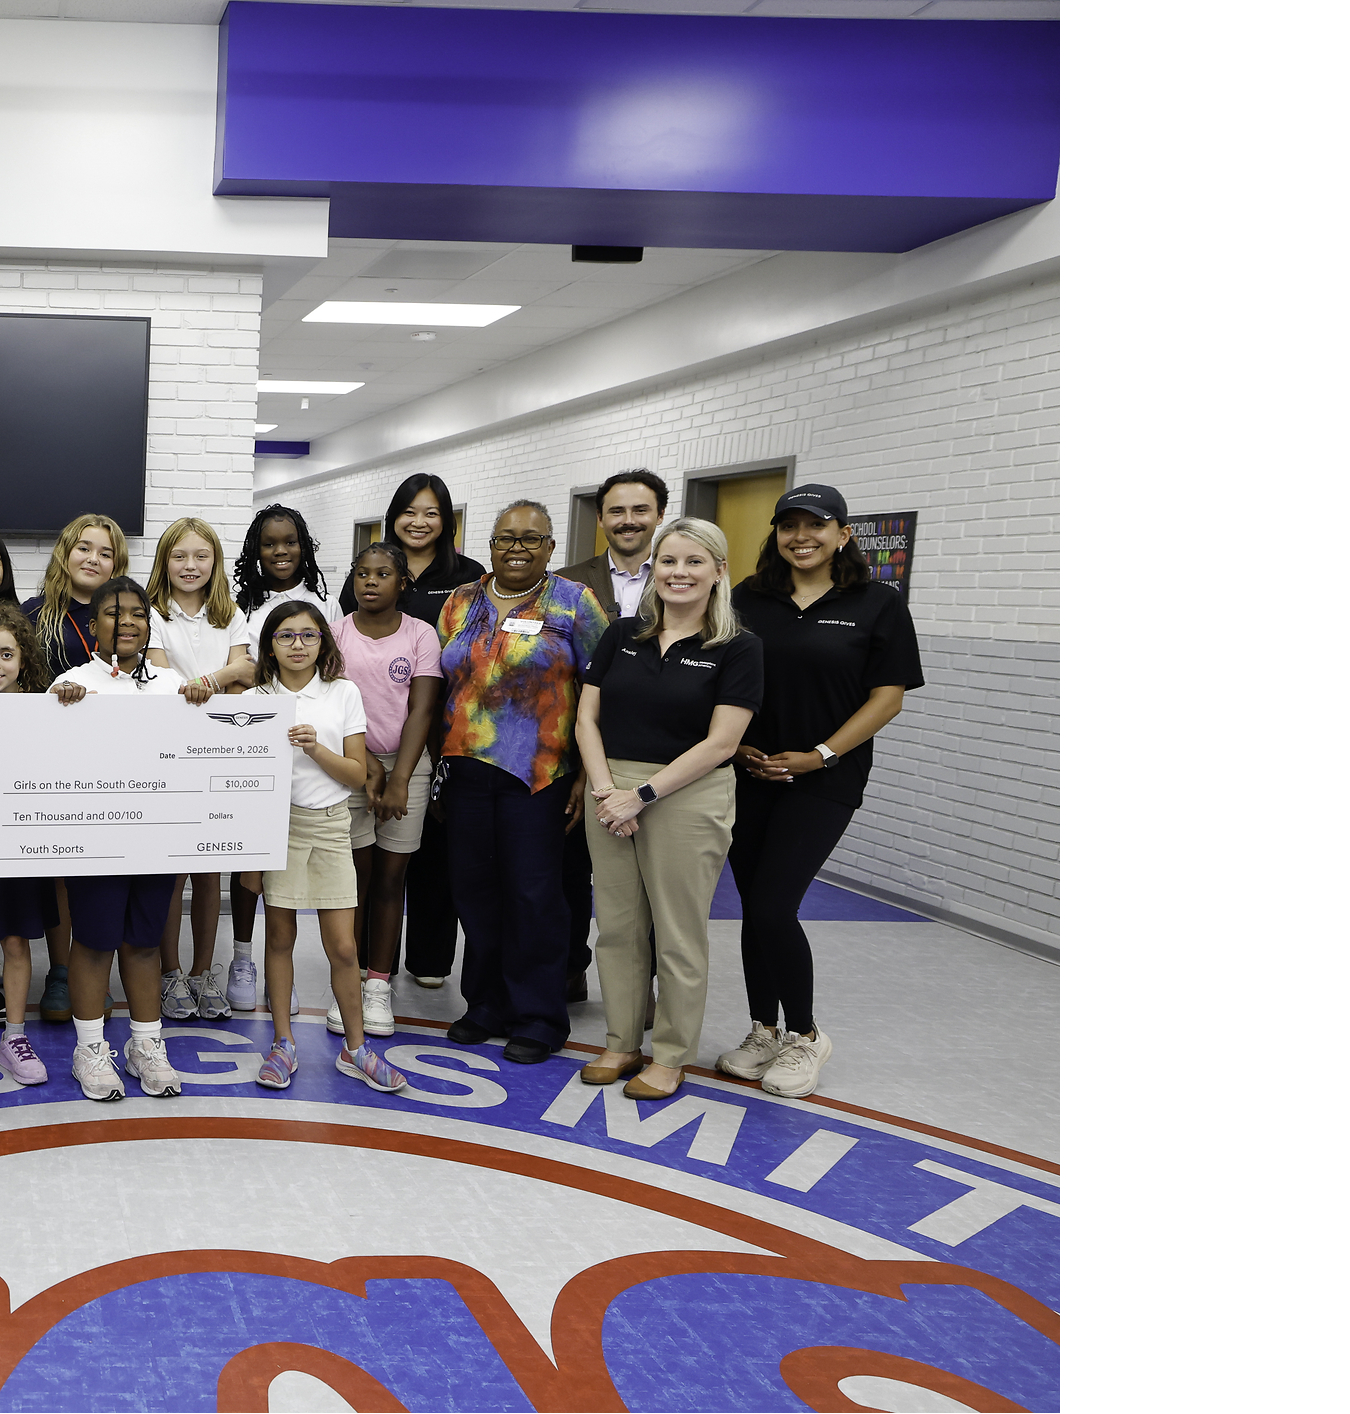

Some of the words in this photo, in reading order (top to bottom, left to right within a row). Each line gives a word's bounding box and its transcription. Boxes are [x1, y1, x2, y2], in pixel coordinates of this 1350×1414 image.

[850, 522, 877, 536] SCHOOL
[858, 535, 908, 551] COUNSELORS:
[392, 665, 409, 676] JGS
[187, 746, 234, 755] September
[237, 746, 244, 754] 9,
[14, 781, 35, 789] Girls
[37, 782, 51, 790] on
[55, 781, 71, 789] the
[75, 781, 93, 789] Run
[97, 780, 125, 789] South
[128, 779, 167, 791] Georgia
[226, 780, 259, 789] $10,000
[13, 812, 31, 821] Ten
[35, 812, 83, 820] Thousand
[86, 811, 104, 820] and
[108, 811, 142, 820] 00/100
[20, 845, 49, 854] Youth
[52, 845, 84, 855] Sports
[197, 842, 243, 851] GENESIS
